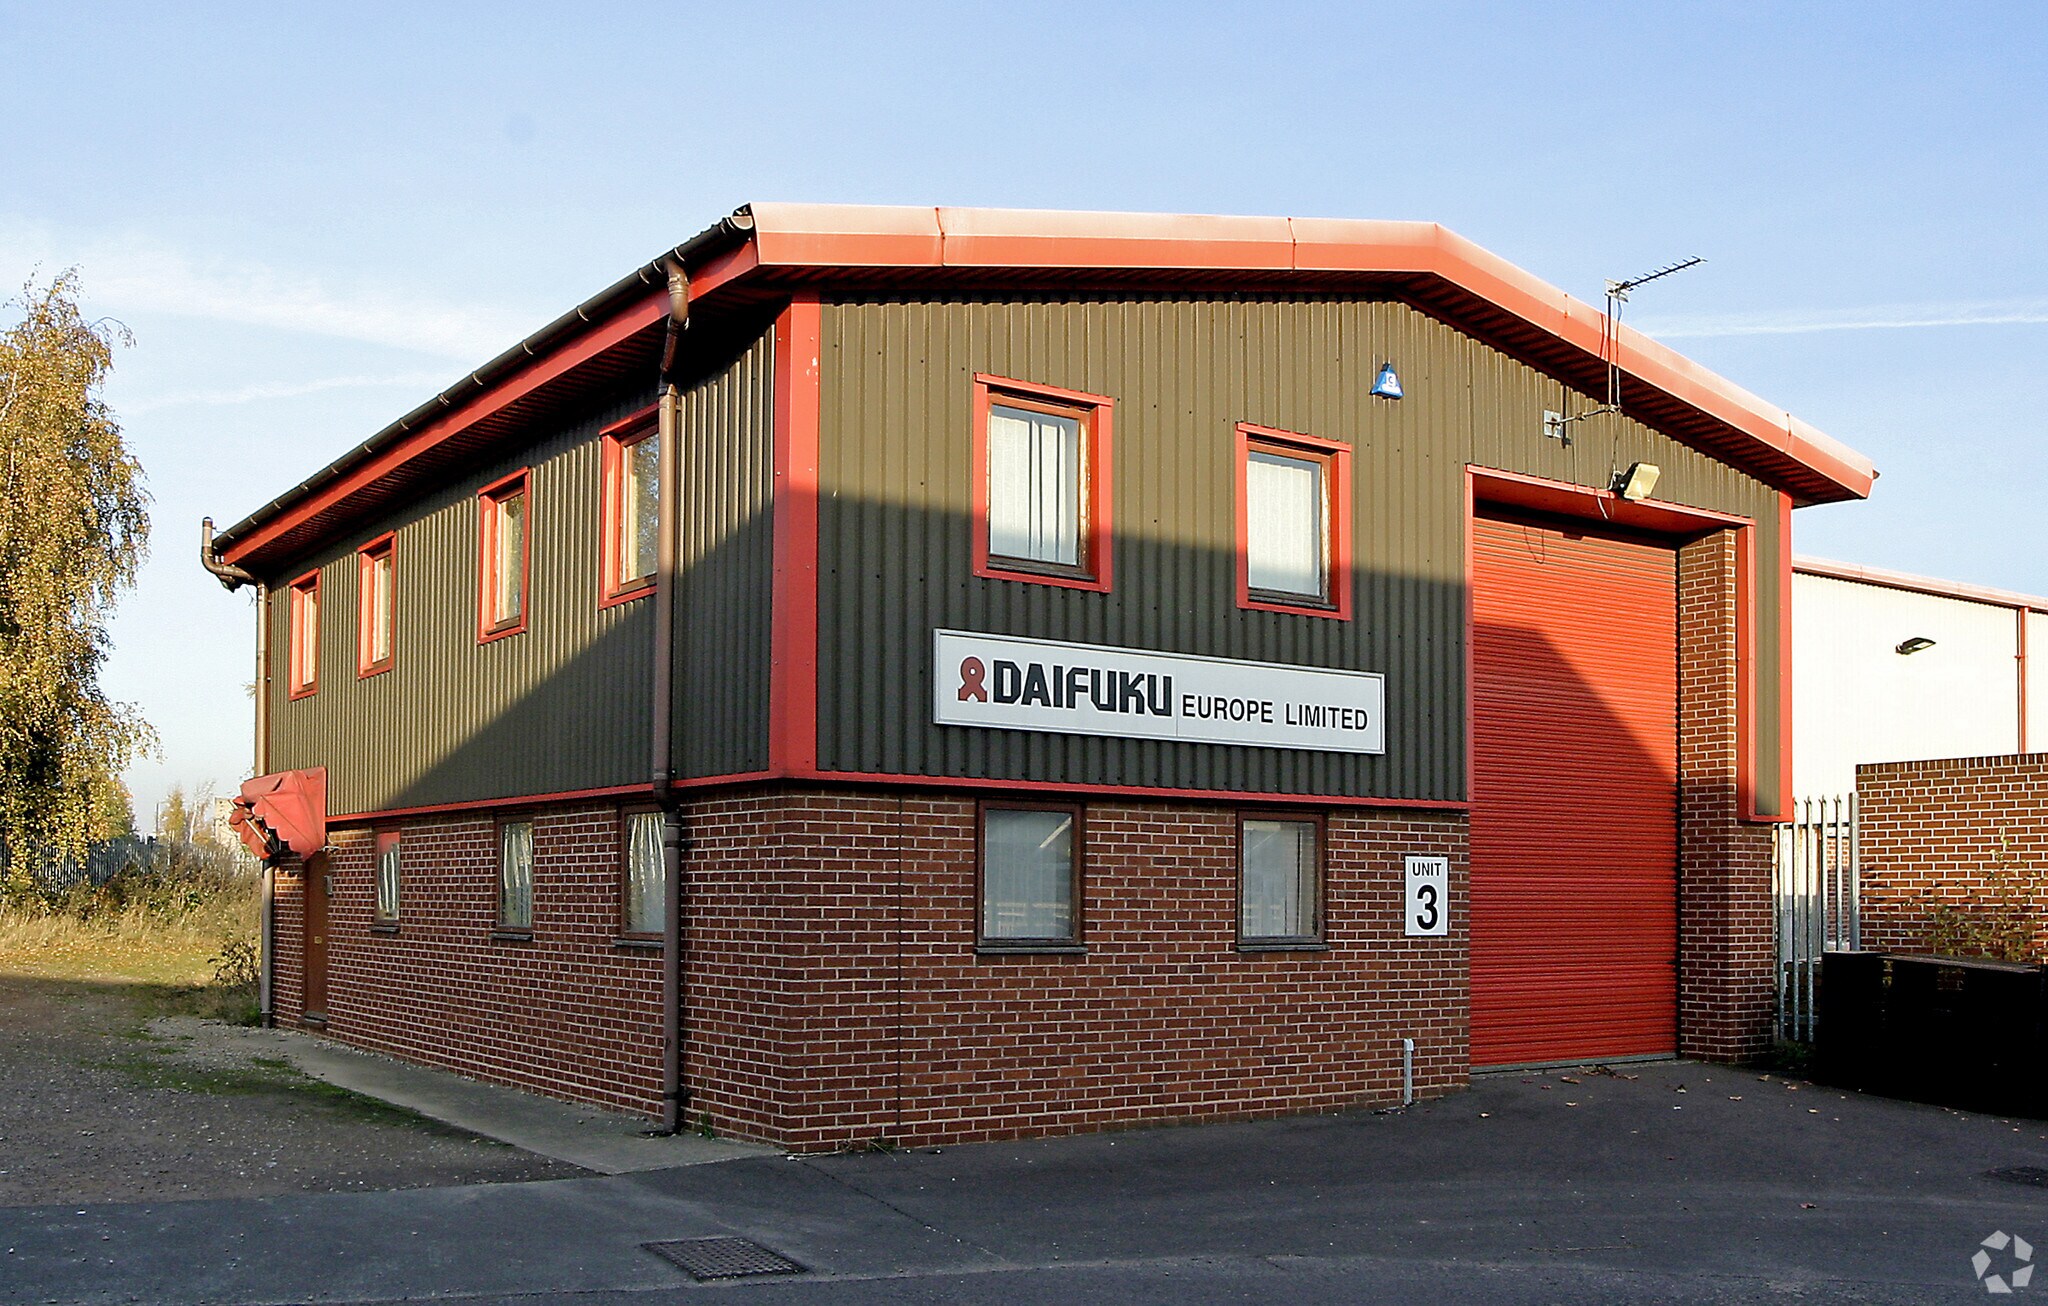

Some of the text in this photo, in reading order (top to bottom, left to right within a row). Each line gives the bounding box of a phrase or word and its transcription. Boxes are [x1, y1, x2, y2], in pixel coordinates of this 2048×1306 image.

[993, 660, 1369, 731] DAIFUKU EUROPE LIMITED
[1412, 862, 1442, 876] UNIT
[1416, 884, 1438, 930] 3
